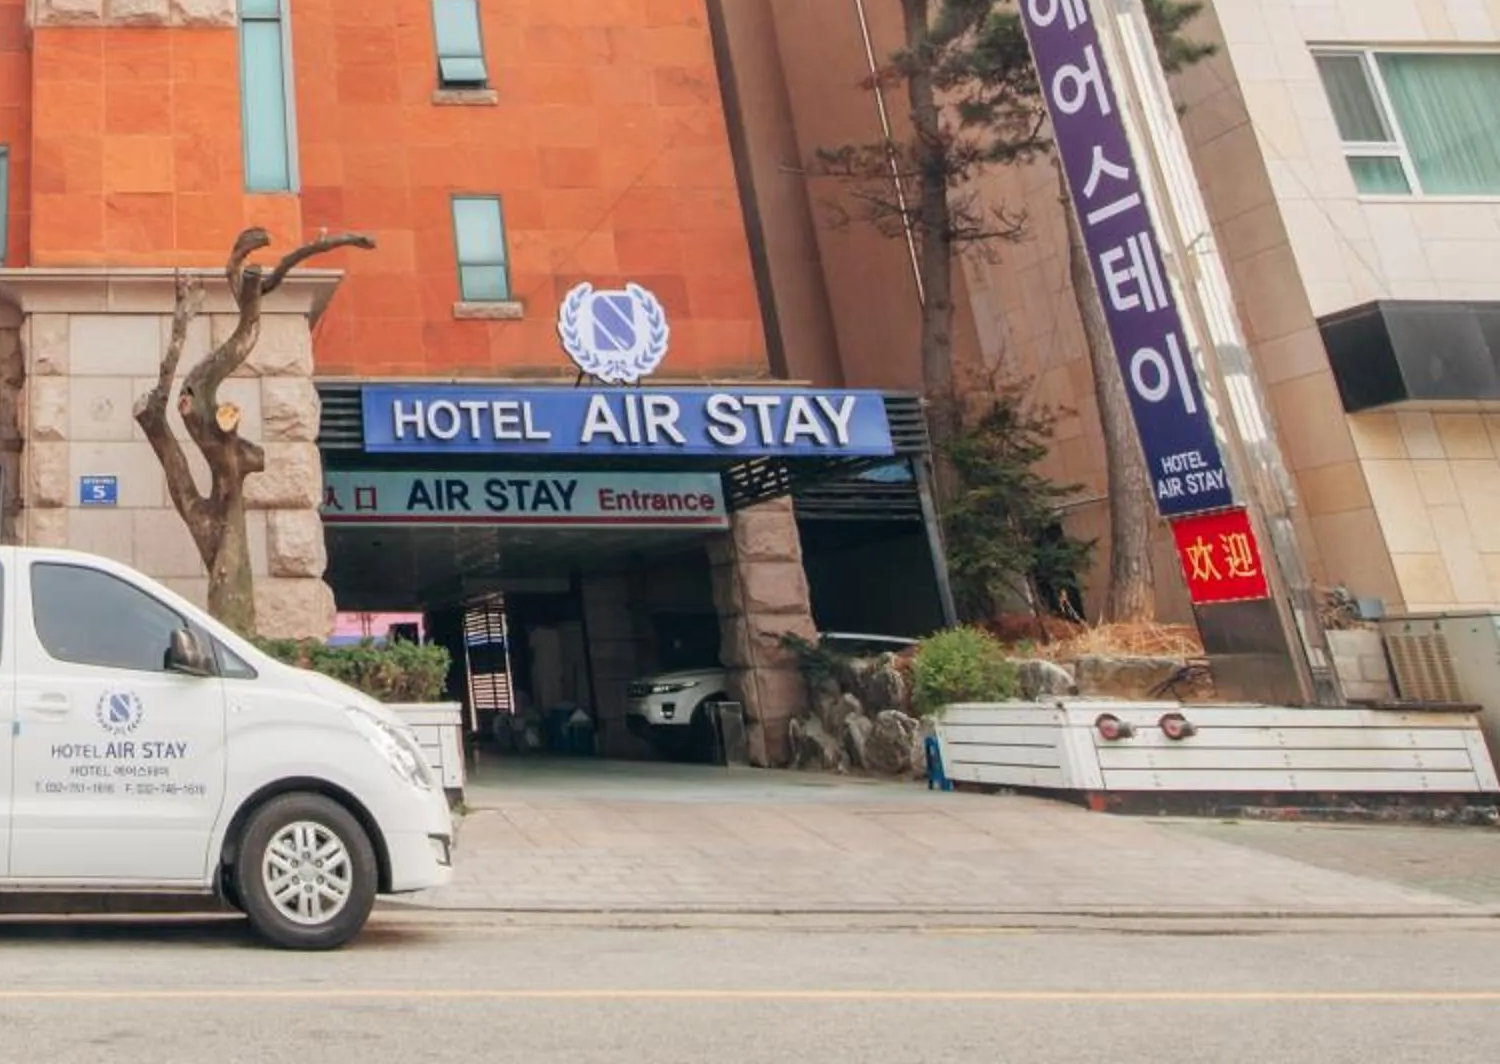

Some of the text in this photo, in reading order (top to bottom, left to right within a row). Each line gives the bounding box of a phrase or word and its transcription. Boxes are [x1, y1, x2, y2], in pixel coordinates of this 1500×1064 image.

[392, 393, 858, 447] HOTEL AIR STAY
[1161, 450, 1209, 474] HOTEL
[406, 479, 472, 513] AIR
[484, 478, 579, 513] STAY
[598, 487, 716, 513] Entrance
[1158, 467, 1225, 499] AIR STAY
[1186, 533, 1257, 581] 欢迎
[51, 742, 187, 759] HOTEL AIR STAY
[70, 765, 111, 777] HOTEL
